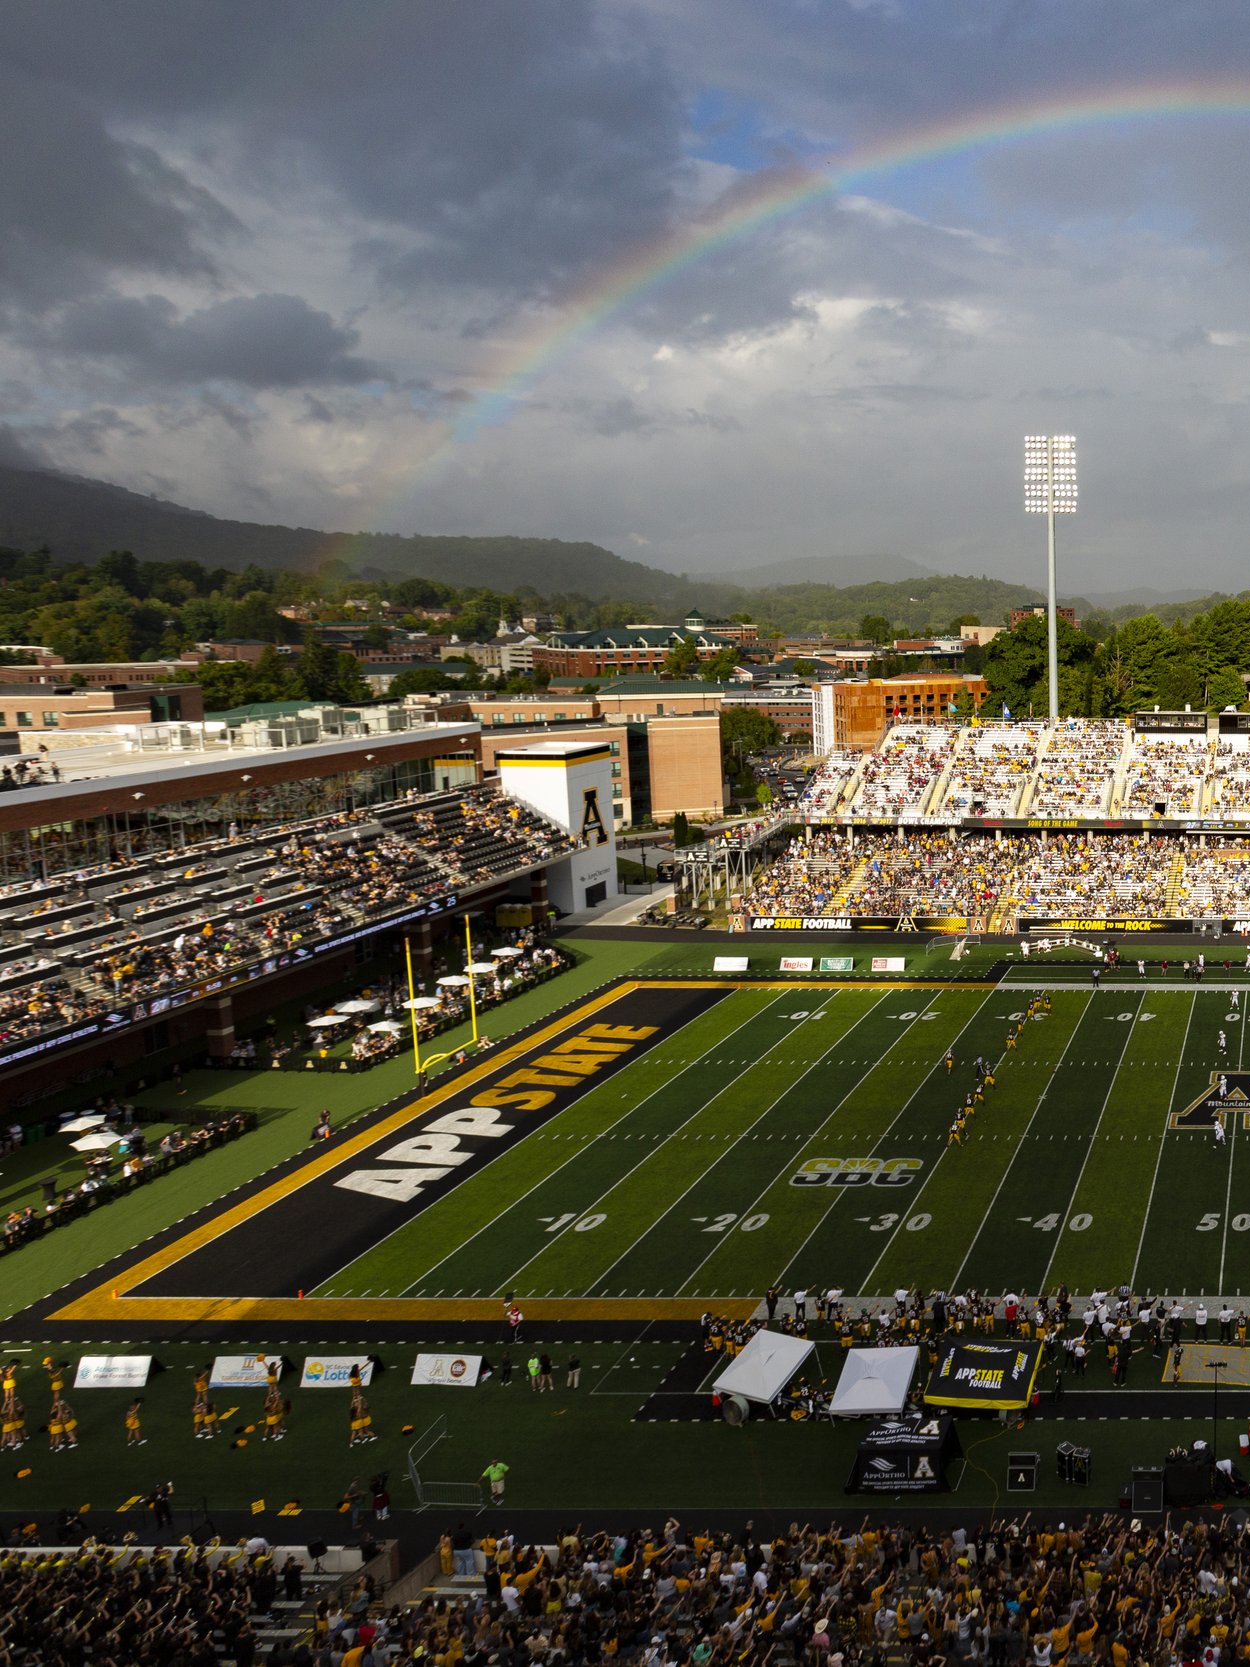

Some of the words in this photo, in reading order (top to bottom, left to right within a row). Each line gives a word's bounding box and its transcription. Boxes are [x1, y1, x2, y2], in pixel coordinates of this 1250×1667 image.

[582, 786, 609, 847] A
[446, 896, 457, 907] 25
[732, 917, 742, 931] A
[753, 918, 774, 929] APP
[774, 918, 802, 930] STATE
[802, 919, 852, 930] FOOTBALL
[973, 918, 984, 931] A
[1003, 918, 1014, 931] A
[1061, 920, 1105, 930] WELCOME
[1125, 920, 1150, 930] ROCK
[784, 960, 808, 969] ingles
[150, 998, 170, 1013] 27
[790, 1011, 828, 1020] 10
[899, 1011, 942, 1020] 20
[1116, 1012, 1157, 1021] 40
[468, 1023, 662, 1110] STATE
[332, 1106, 516, 1203] APP
[789, 1158, 924, 1187] SBC
[544, 1213, 607, 1232] 10
[700, 1213, 770, 1232] 20
[869, 1213, 932, 1232] 30
[1032, 1214, 1093, 1232] 40
[1015, 1351, 1025, 1368] STATE
[1020, 1353, 1029, 1372] FOOTBALL
[324, 1370, 368, 1381] Lotty
[955, 1368, 976, 1380] APP
[975, 1369, 1006, 1382] STATE
[1011, 1366, 1021, 1380] APP
[969, 1380, 1002, 1389] FOOTBALL
[918, 1420, 940, 1435] A
[913, 1456, 936, 1478] A
